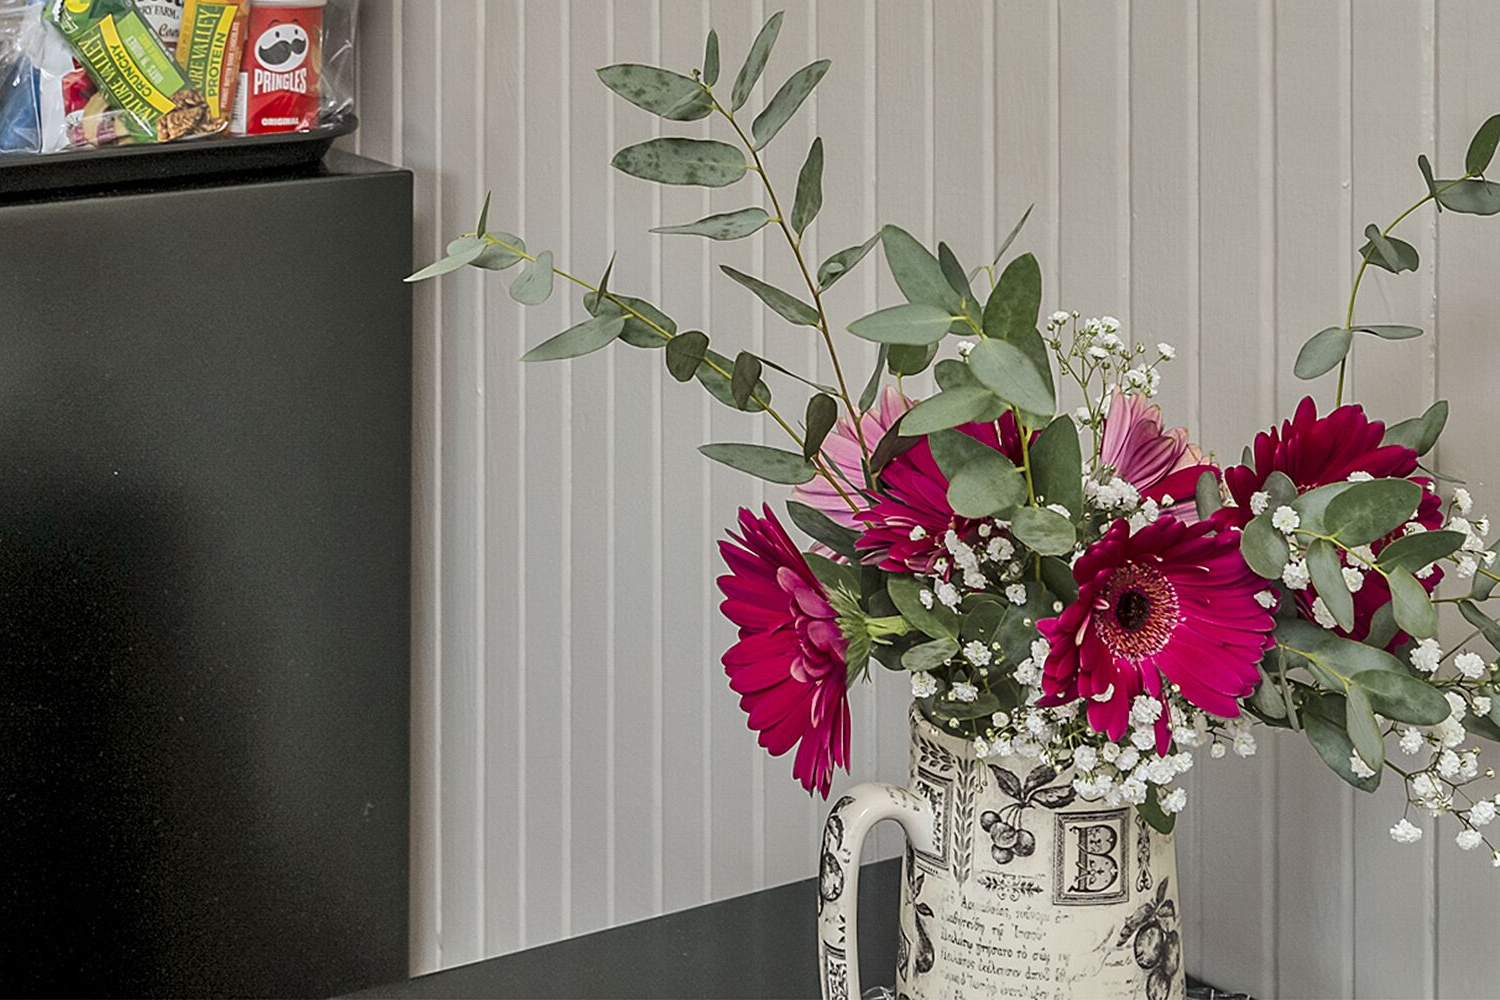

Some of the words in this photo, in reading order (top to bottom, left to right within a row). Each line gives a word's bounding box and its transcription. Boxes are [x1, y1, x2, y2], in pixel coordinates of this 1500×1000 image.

[78, 34, 115, 82] VALLEY
[191, 8, 221, 58] VALLEY
[110, 44, 151, 97] CRUNCHY
[208, 32, 226, 97] PROTEIN
[254, 67, 307, 95] PRINGLES
[261, 117, 299, 126] ORIGINAL
[1069, 824, 1118, 893] B
